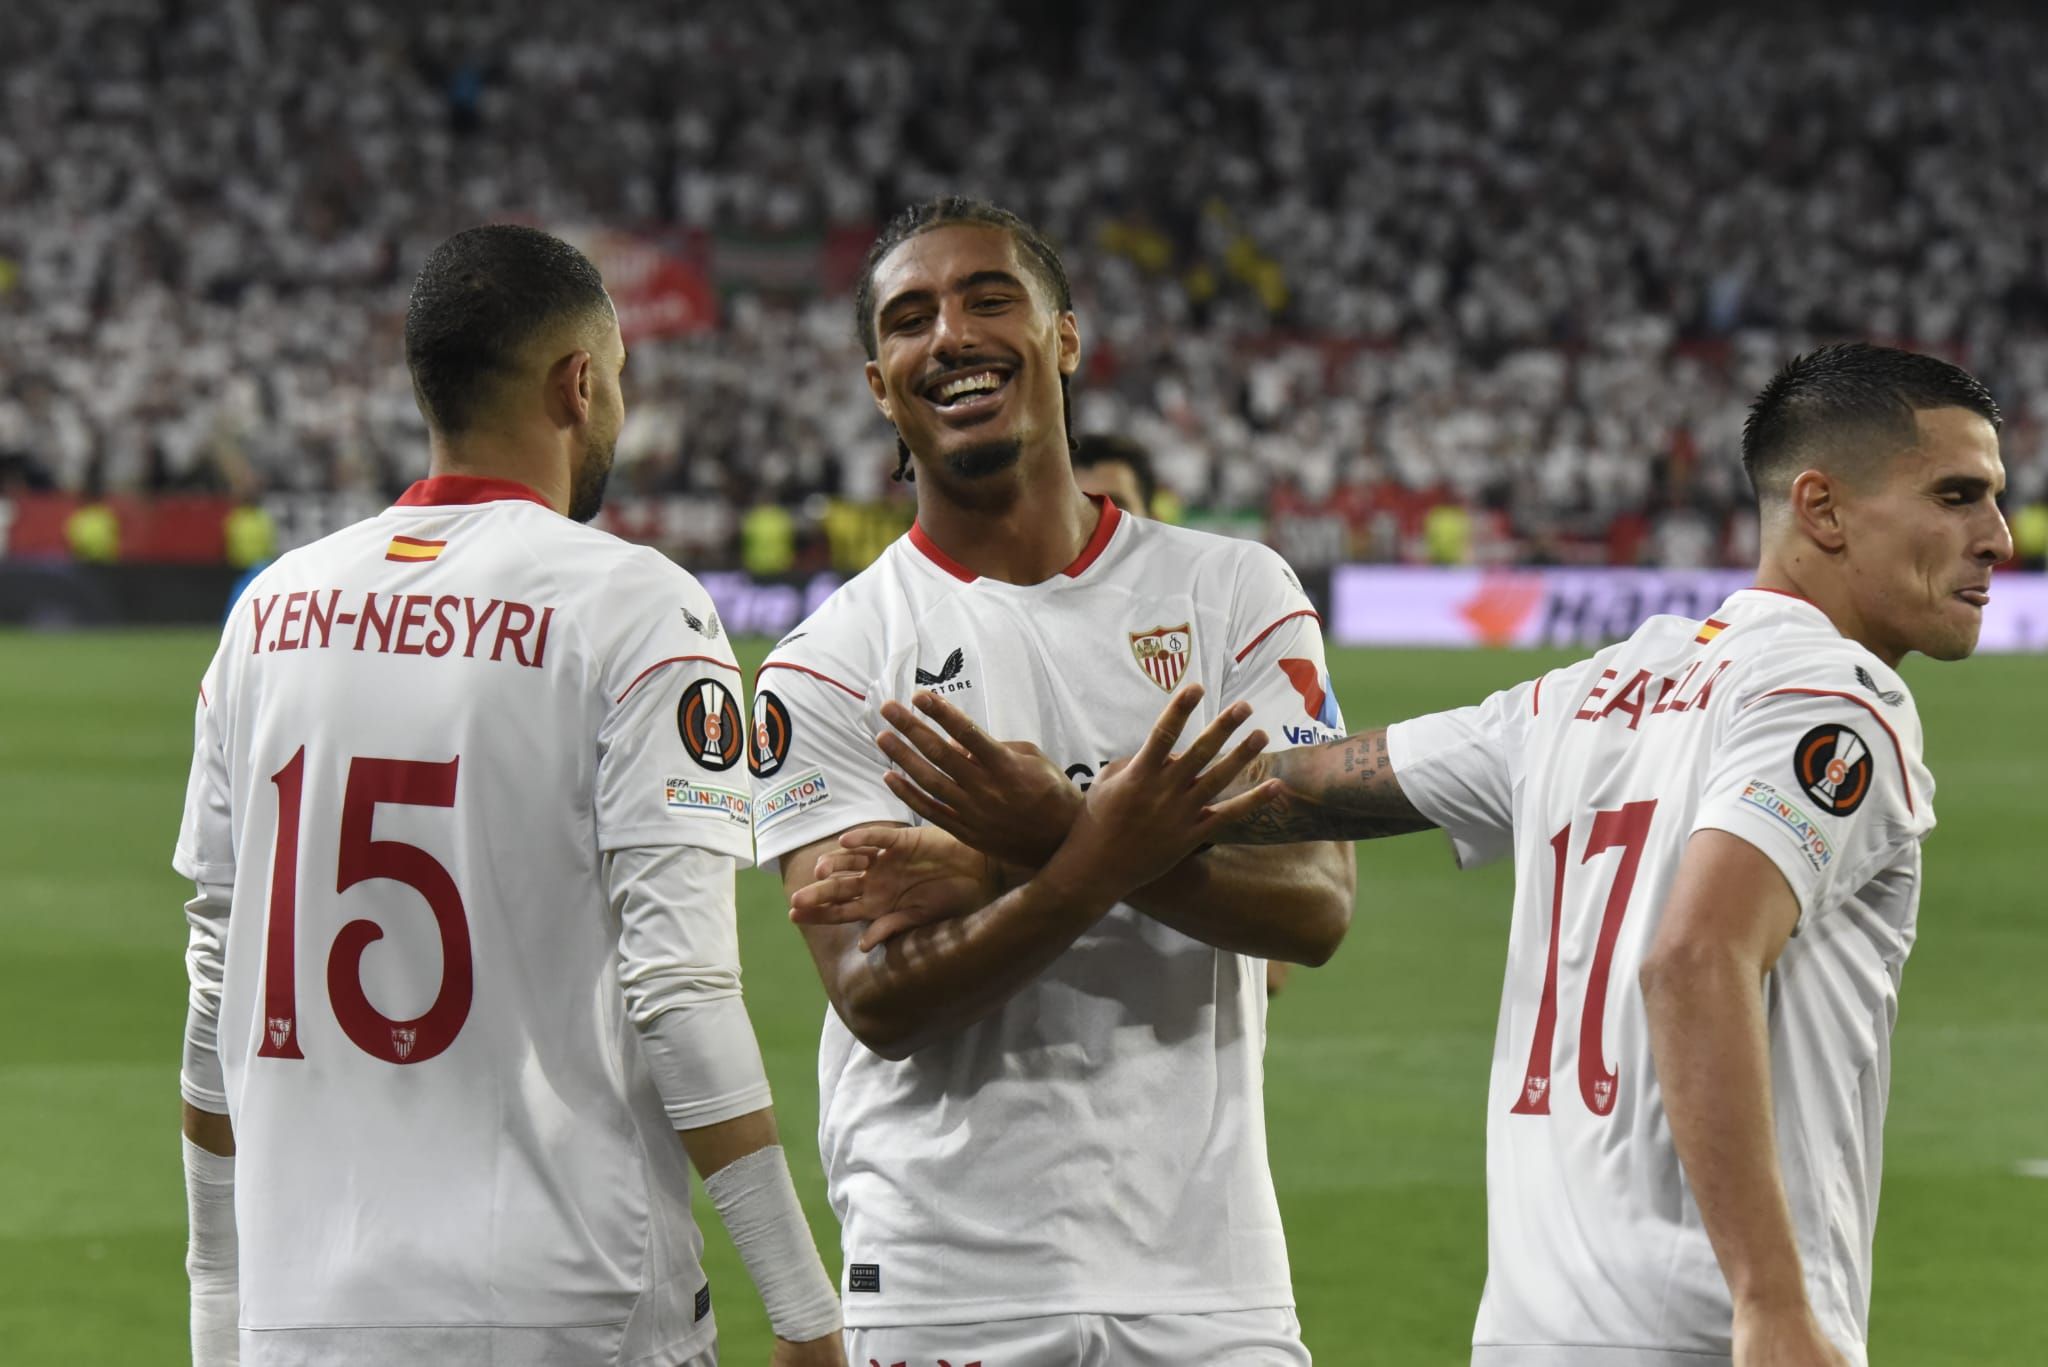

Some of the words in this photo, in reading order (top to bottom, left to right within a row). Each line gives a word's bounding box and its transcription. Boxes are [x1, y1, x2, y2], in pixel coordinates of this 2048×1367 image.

[252, 589, 555, 668] Y.EN-NESYRI
[930, 680, 972, 695] STORE
[704, 713, 721, 742] 6
[757, 721, 770, 750] 6
[666, 778, 689, 788] UEFA
[1750, 779, 1776, 793] UEFA
[1825, 758, 1847, 786] 6
[666, 788, 750, 815] FOUNDATION
[759, 777, 825, 817] UNDATION
[1742, 786, 1831, 865] FOUNDATION
[257, 744, 473, 1065] 15
[1510, 798, 1658, 1117] 17
